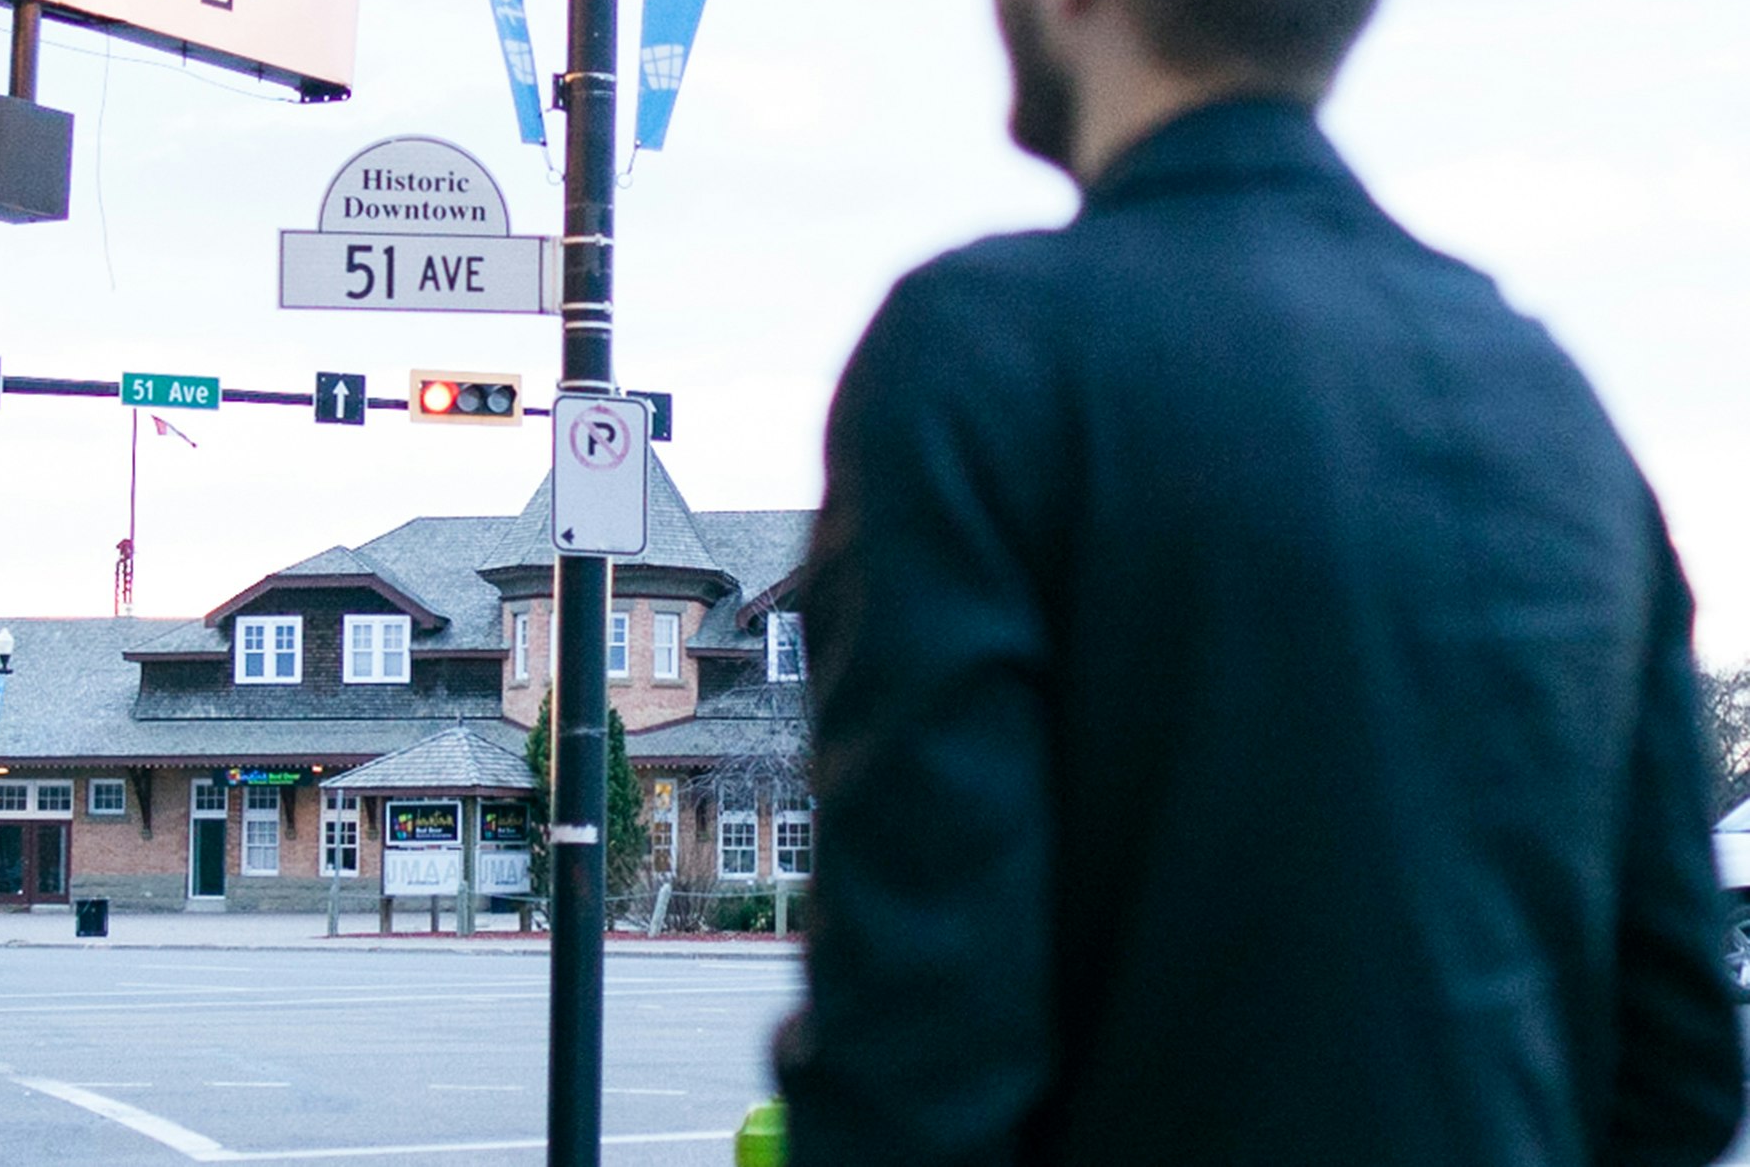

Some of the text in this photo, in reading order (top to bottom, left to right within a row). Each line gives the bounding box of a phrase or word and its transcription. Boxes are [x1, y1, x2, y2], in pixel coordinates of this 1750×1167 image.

[361, 169, 470, 193] Historic
[343, 196, 487, 222] Downtown
[346, 244, 486, 300] 51 AVE
[132, 378, 210, 405] 51 Ave
